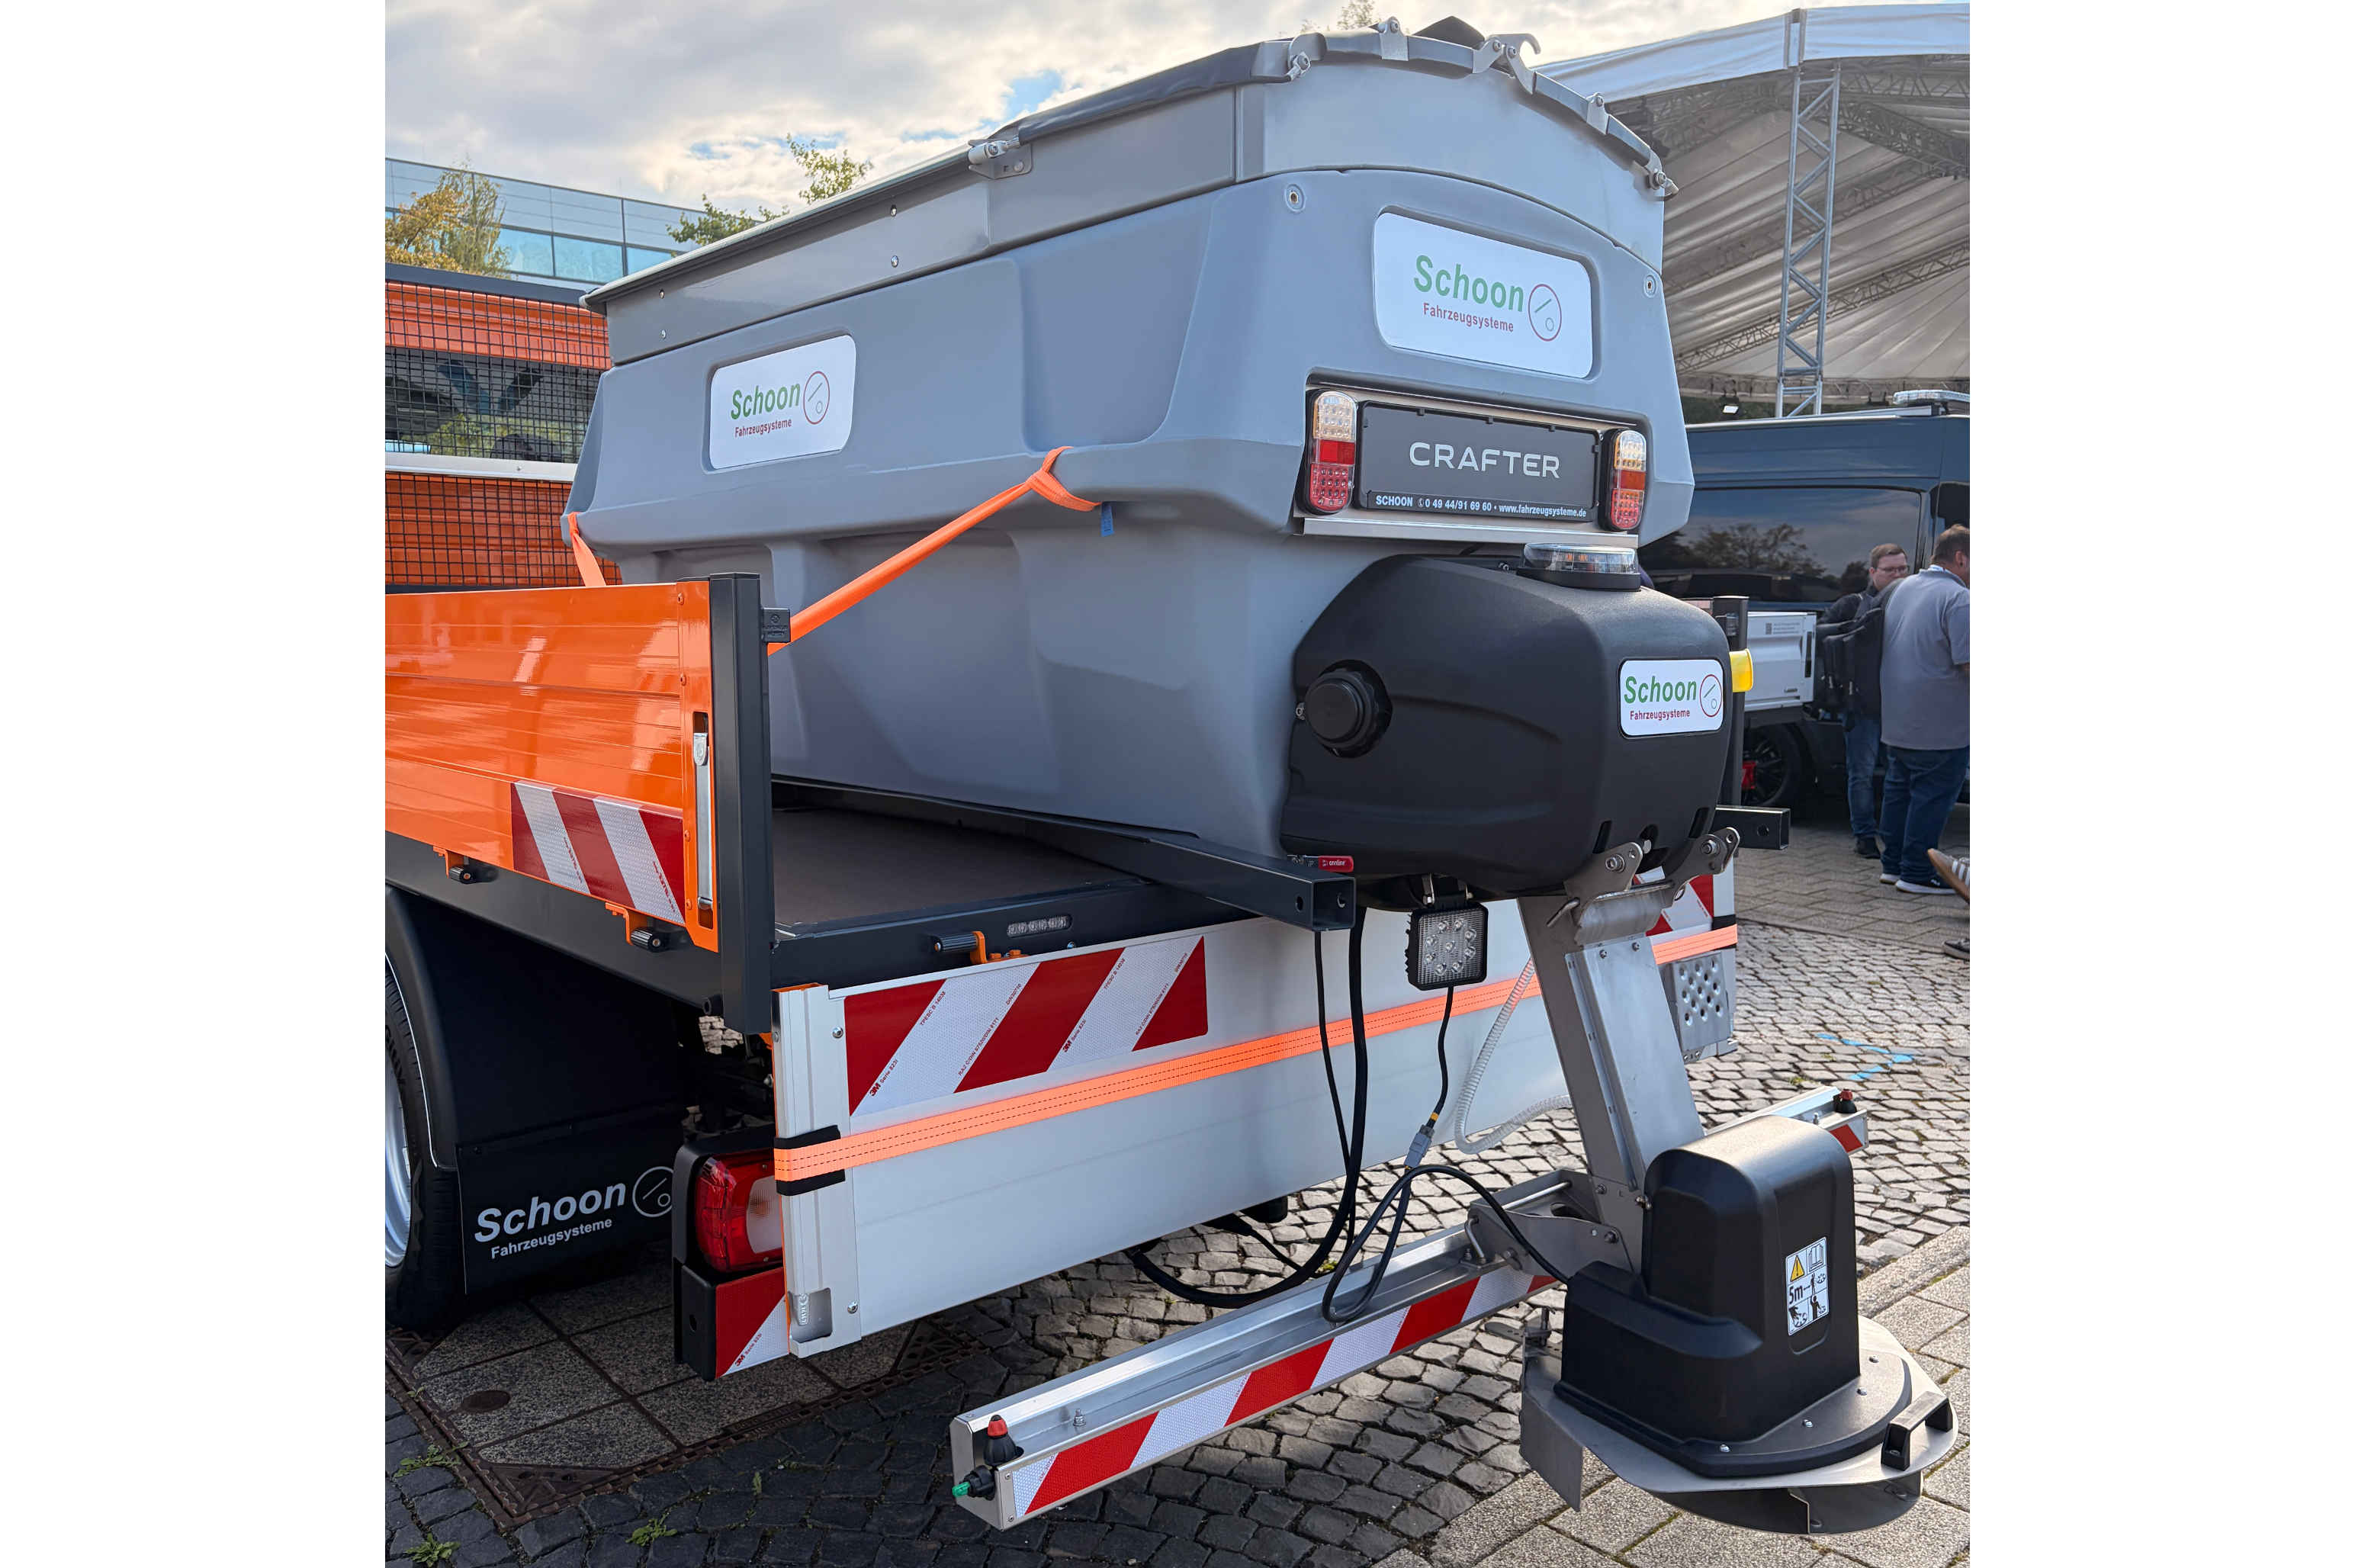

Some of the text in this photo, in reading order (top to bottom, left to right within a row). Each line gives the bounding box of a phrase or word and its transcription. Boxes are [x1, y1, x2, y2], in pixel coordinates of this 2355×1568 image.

[1413, 255, 1524, 313] Schoon
[1422, 302, 1515, 333] Fahrzeugsysteme
[730, 382, 801, 420] Schoon
[734, 419, 792, 438] Fahrzeugsysteme
[1409, 442, 1560, 479] CRAFTER
[1375, 496, 1412, 507] SCHOON
[1432, 500, 1443, 509] 49
[1444, 500, 1467, 510] 44/91
[1470, 502, 1480, 511] 69
[1483, 502, 1492, 512] 60
[1499, 504, 1586, 518] www.fahrzeugsysteme.de
[1624, 676, 1697, 705] Schoon
[1630, 708, 1690, 721] Fahrzeugsysteme
[869, 1082, 882, 1097] 3M
[474, 1182, 626, 1242] Schoon
[491, 1219, 612, 1259] Fahrzeugsysteme
[1788, 1285, 1804, 1305] 5m
[734, 1354, 746, 1367] 3M
